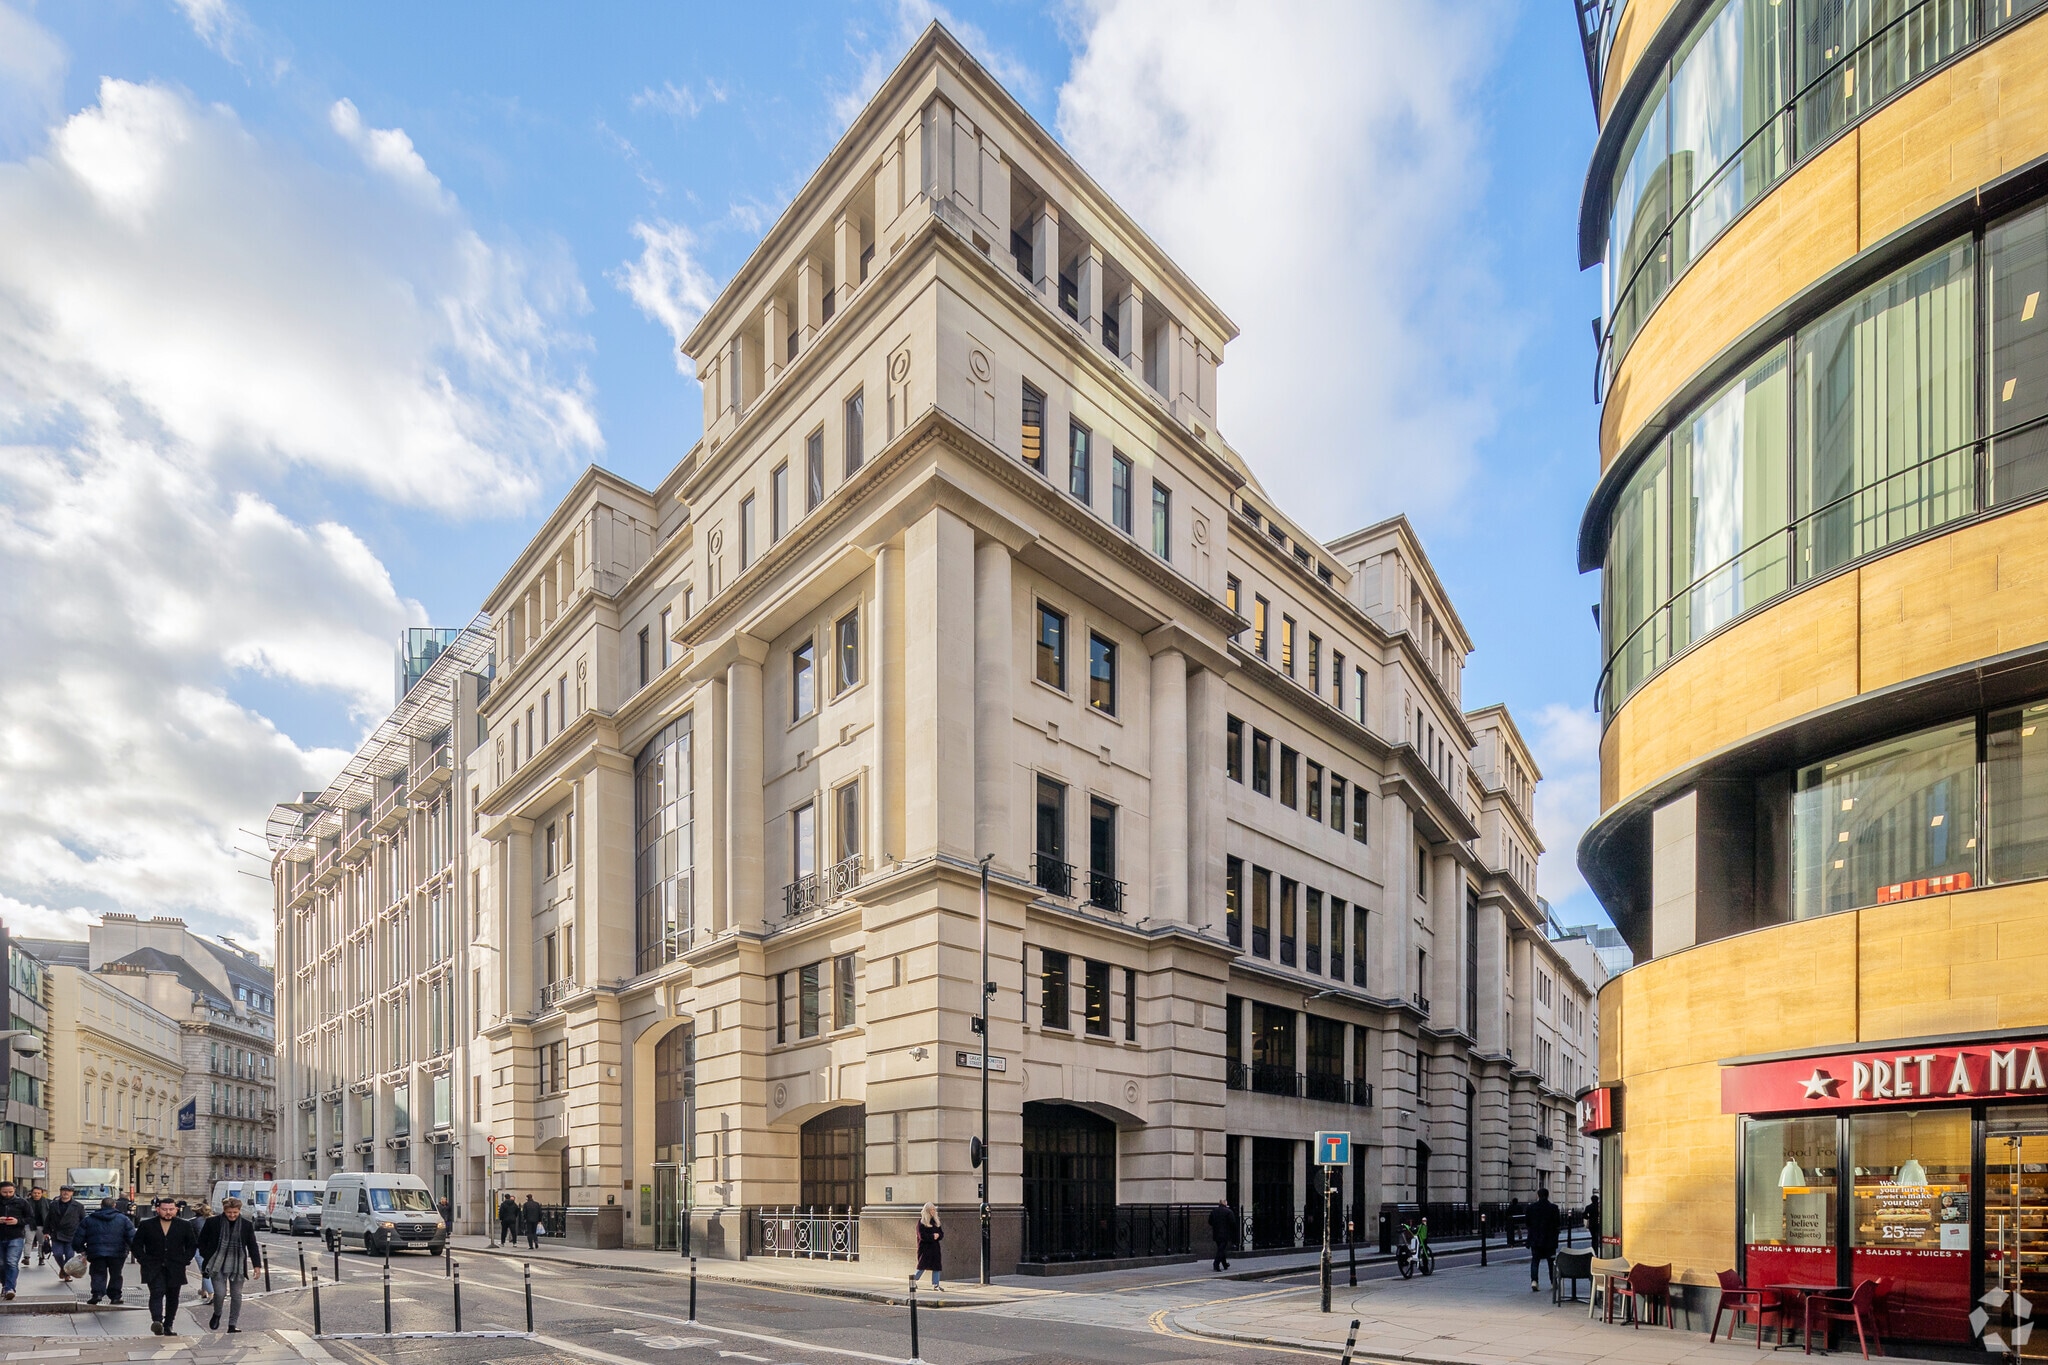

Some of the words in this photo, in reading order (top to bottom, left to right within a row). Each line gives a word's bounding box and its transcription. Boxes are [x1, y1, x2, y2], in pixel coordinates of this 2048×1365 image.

[1852, 1053, 1937, 1100] PRET
[1947, 1051, 1974, 1095] A
[1879, 1187, 1899, 1195] your
[1882, 1200, 1903, 1208] your
[1903, 1199, 1923, 1207] day!
[1791, 1219, 1819, 1227] believe
[1882, 1225, 1905, 1239] £5
[1757, 1245, 1784, 1253] MOCHA
[1865, 1248, 1902, 1256] SALADS
[1916, 1249, 1952, 1257] JUICES
